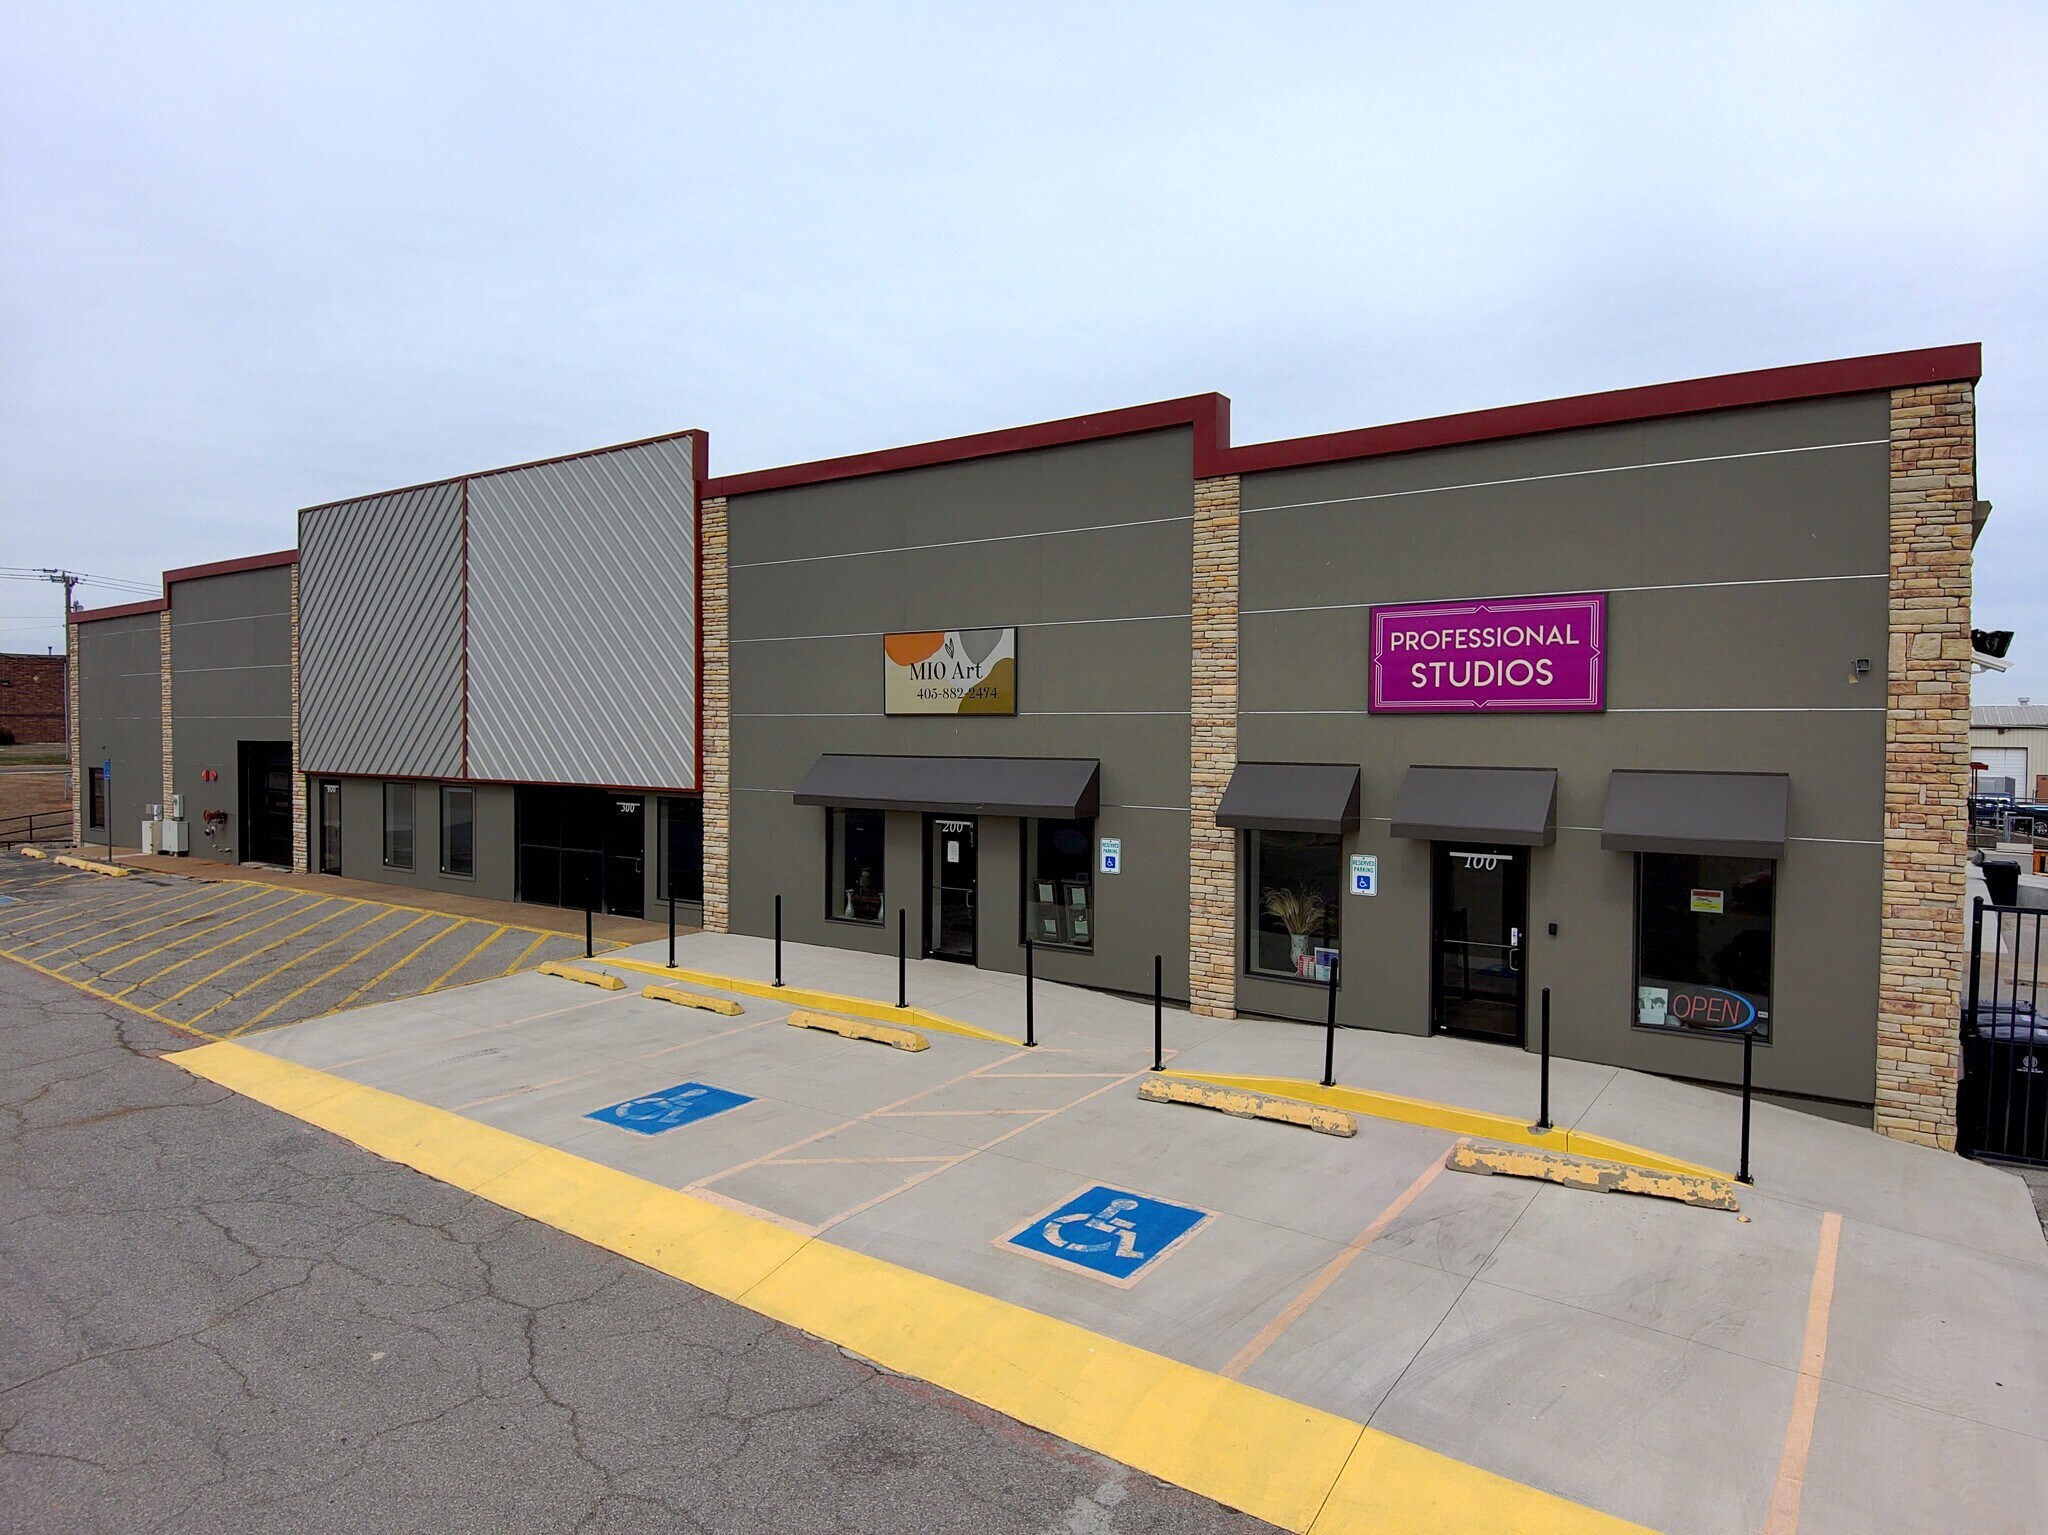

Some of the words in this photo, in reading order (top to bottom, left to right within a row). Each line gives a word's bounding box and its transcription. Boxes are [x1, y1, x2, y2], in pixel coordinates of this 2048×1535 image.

[1390, 623, 1580, 652] PROFESSIONAL
[910, 661, 946, 681] MIO
[951, 661, 984, 680] Art
[1411, 658, 1553, 688] STUDIOS
[917, 686, 998, 700] 405-882-2474
[620, 803, 635, 813] 300
[942, 822, 964, 833] 200
[1353, 866, 1374, 874] PARKING
[1464, 855, 1498, 871] 100
[1672, 994, 1741, 1024] OPEN
